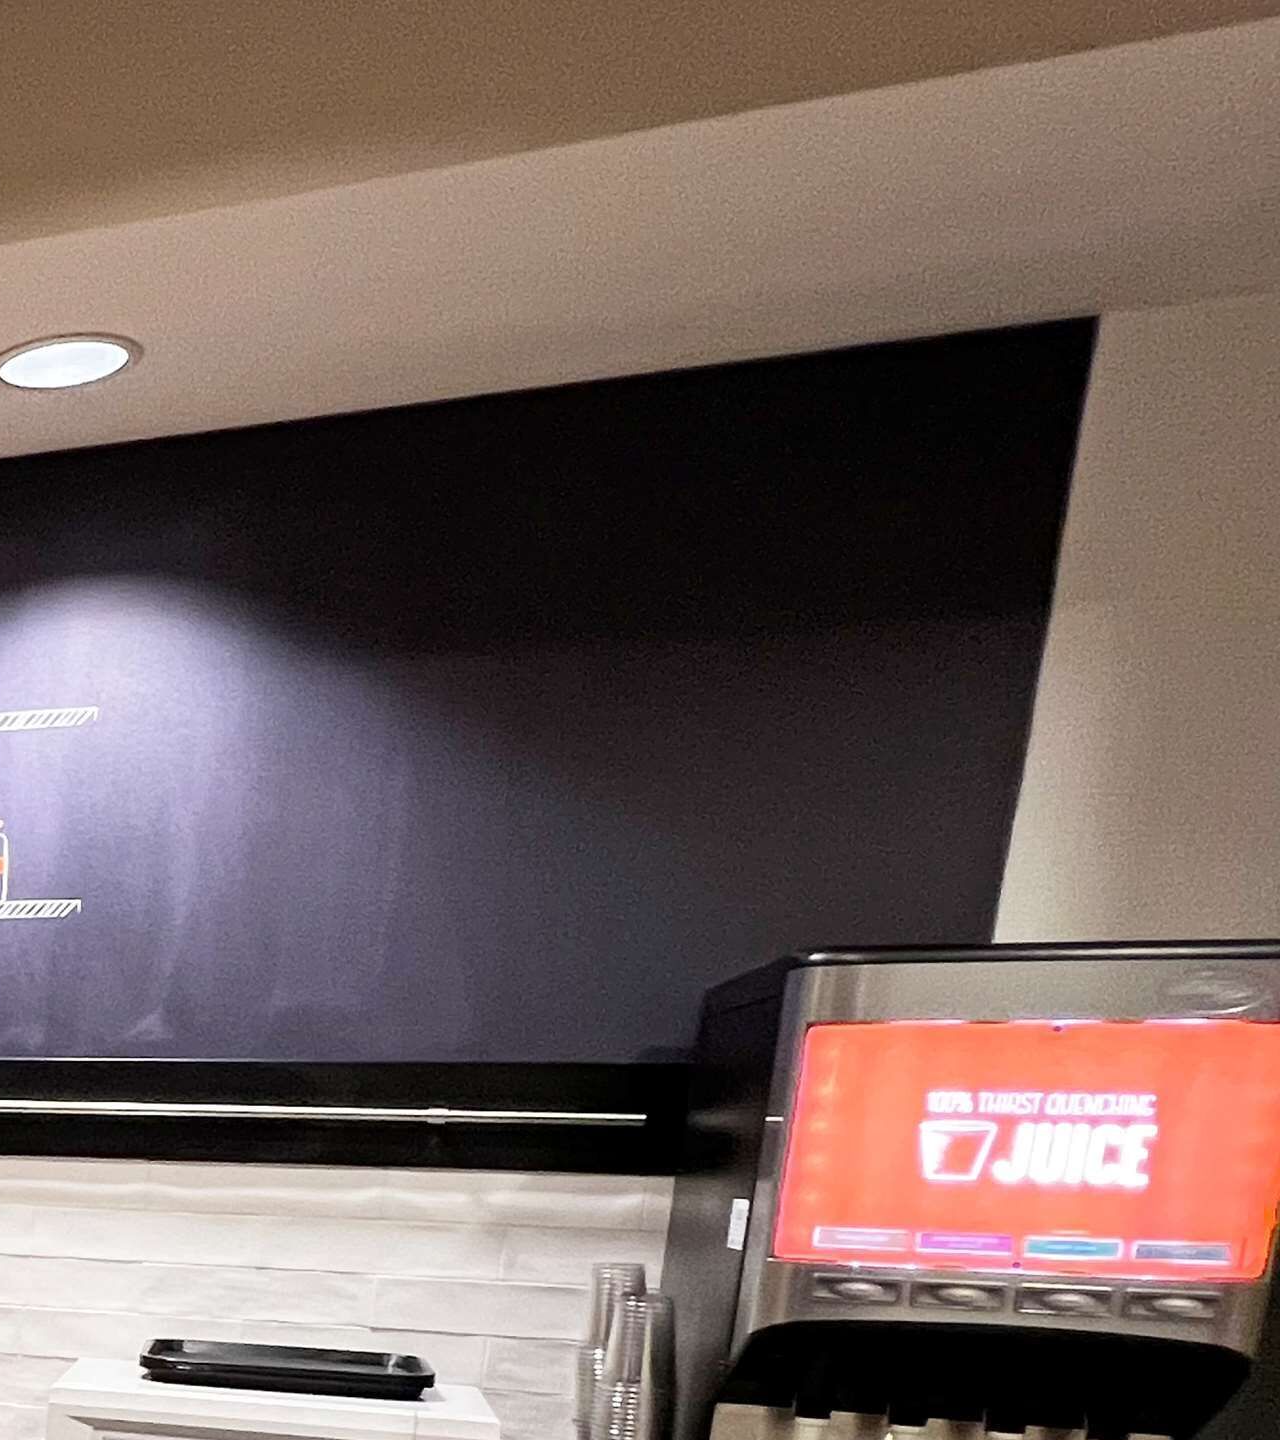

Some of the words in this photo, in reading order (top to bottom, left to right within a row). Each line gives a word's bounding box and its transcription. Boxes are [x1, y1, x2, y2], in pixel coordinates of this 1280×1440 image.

[927, 1091, 973, 1114] 100%
[978, 1092, 1044, 1115] THIRST
[1044, 1092, 1158, 1117] QUENCHING
[991, 1122, 1159, 1188] JUICE
